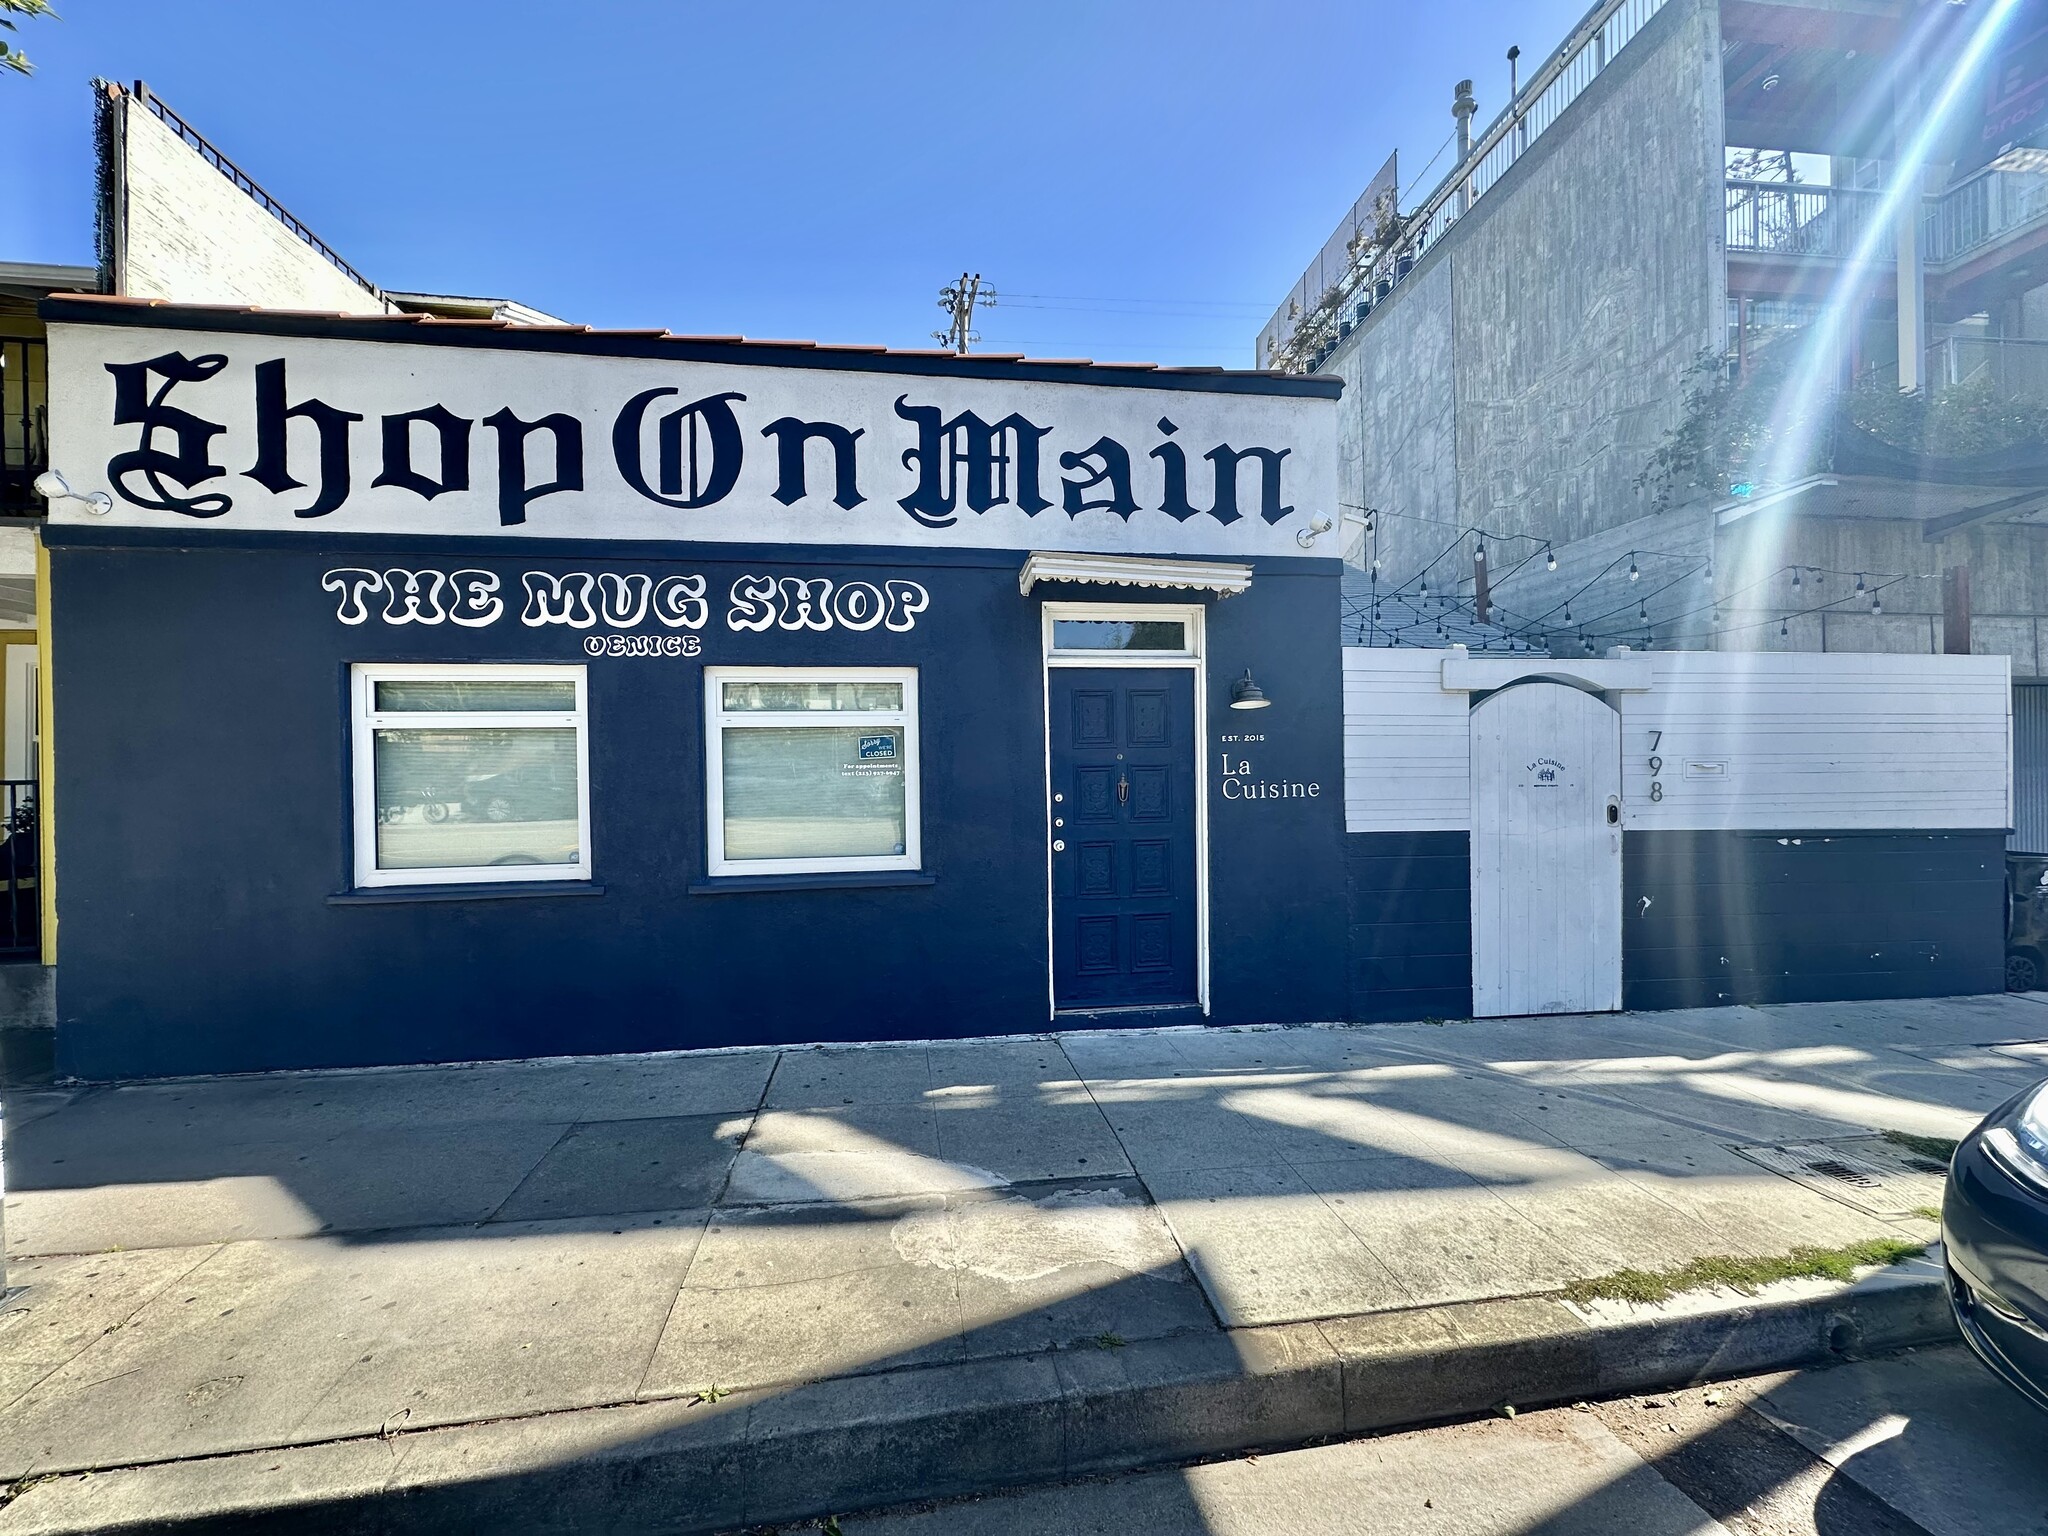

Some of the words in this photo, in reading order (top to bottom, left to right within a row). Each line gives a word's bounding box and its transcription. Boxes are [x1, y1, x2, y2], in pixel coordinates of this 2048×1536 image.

[104, 351, 583, 526] Shop
[613, 387, 867, 510] On
[894, 394, 1294, 528] Main
[321, 567, 504, 628] THE
[520, 570, 709, 630] MUG
[727, 575, 930, 632] SHOP
[1243, 734, 1266, 742] 2015
[1221, 753, 1252, 776] La
[1526, 762, 1538, 772] La
[1537, 757, 1566, 772] Cuisine
[1222, 777, 1321, 801] Cuisine
